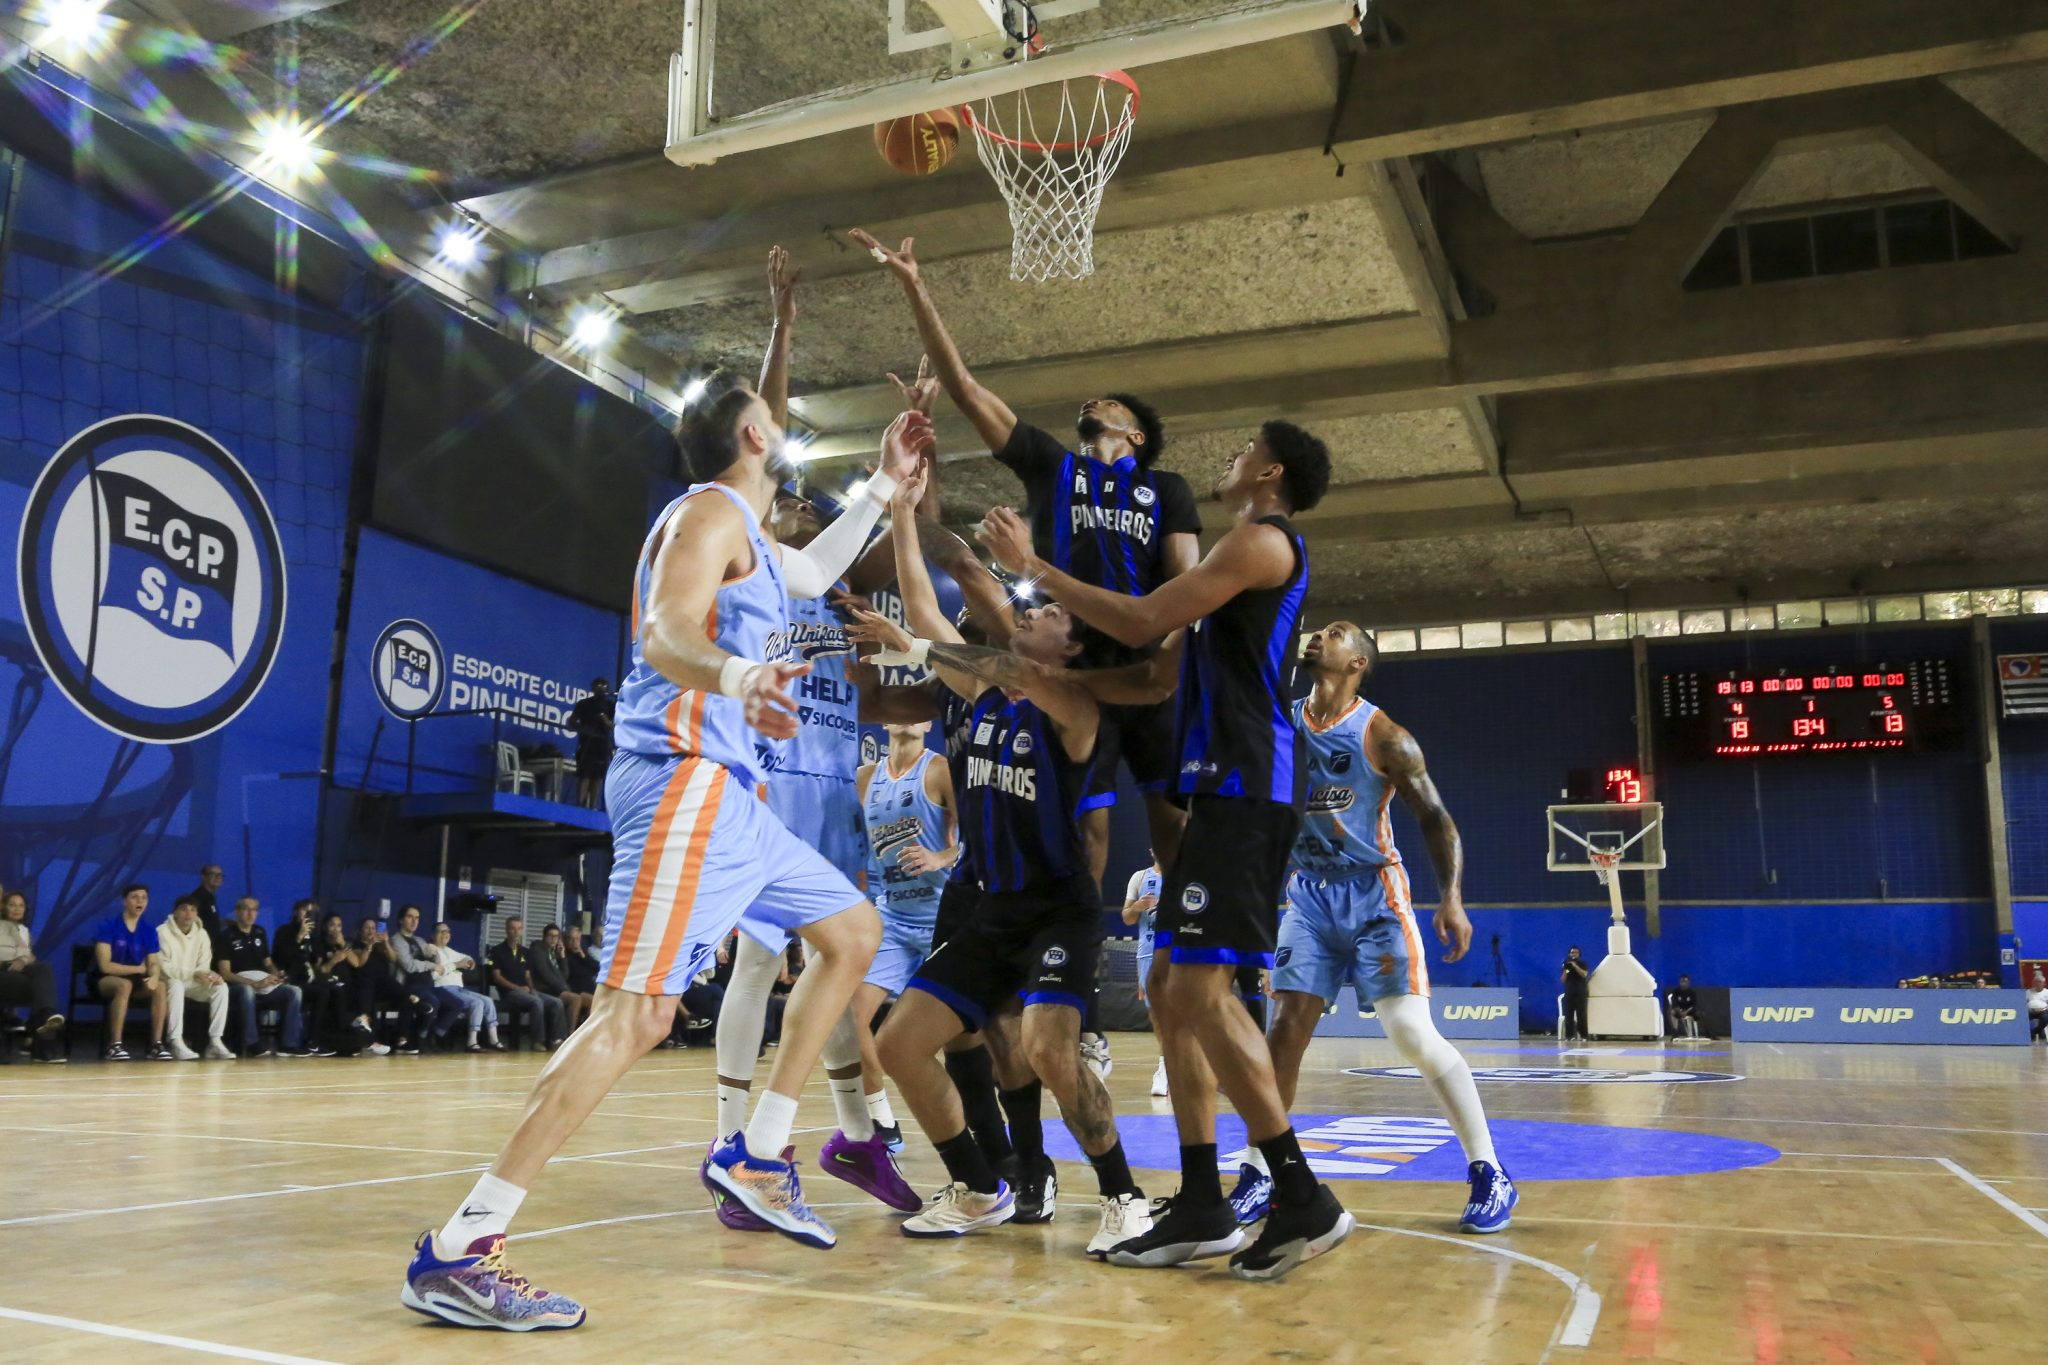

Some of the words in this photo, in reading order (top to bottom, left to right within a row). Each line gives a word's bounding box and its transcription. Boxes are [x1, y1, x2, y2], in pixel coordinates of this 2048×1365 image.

[920, 128, 939, 175] ENALTY
[125, 496, 224, 579] E.C.P.
[136, 566, 202, 629] S.P.
[789, 622, 850, 648] Unifac
[398, 644, 427, 669] E.C.P.
[401, 666, 421, 686] S.P.
[452, 653, 541, 696] ESPORTE
[542, 680, 595, 705] CLUB
[1763, 679, 1780, 692] 00
[1785, 678, 1803, 691] 00
[1813, 677, 1830, 690] 00
[1836, 675, 1853, 688] 00
[1863, 674, 1880, 687] 00
[1886, 673, 1904, 686] 00
[1718, 681, 1731, 694] 19
[1740, 680, 1754, 693] 13
[449, 681, 578, 739] PINHEIRO
[1732, 703, 1743, 715] 4
[1807, 700, 1814, 712] 1
[1883, 695, 1893, 709] 5
[1732, 721, 1749, 739] 19
[1886, 714, 1903, 732] 13
[967, 755, 1036, 802] PINEIROS
[1620, 780, 1641, 803] 13
[1443, 1005, 1509, 1020] UNIP
[1742, 1006, 1815, 1022] UNIP
[1840, 1007, 1914, 1024] UNIP
[1940, 1008, 2017, 1024] UNIP
